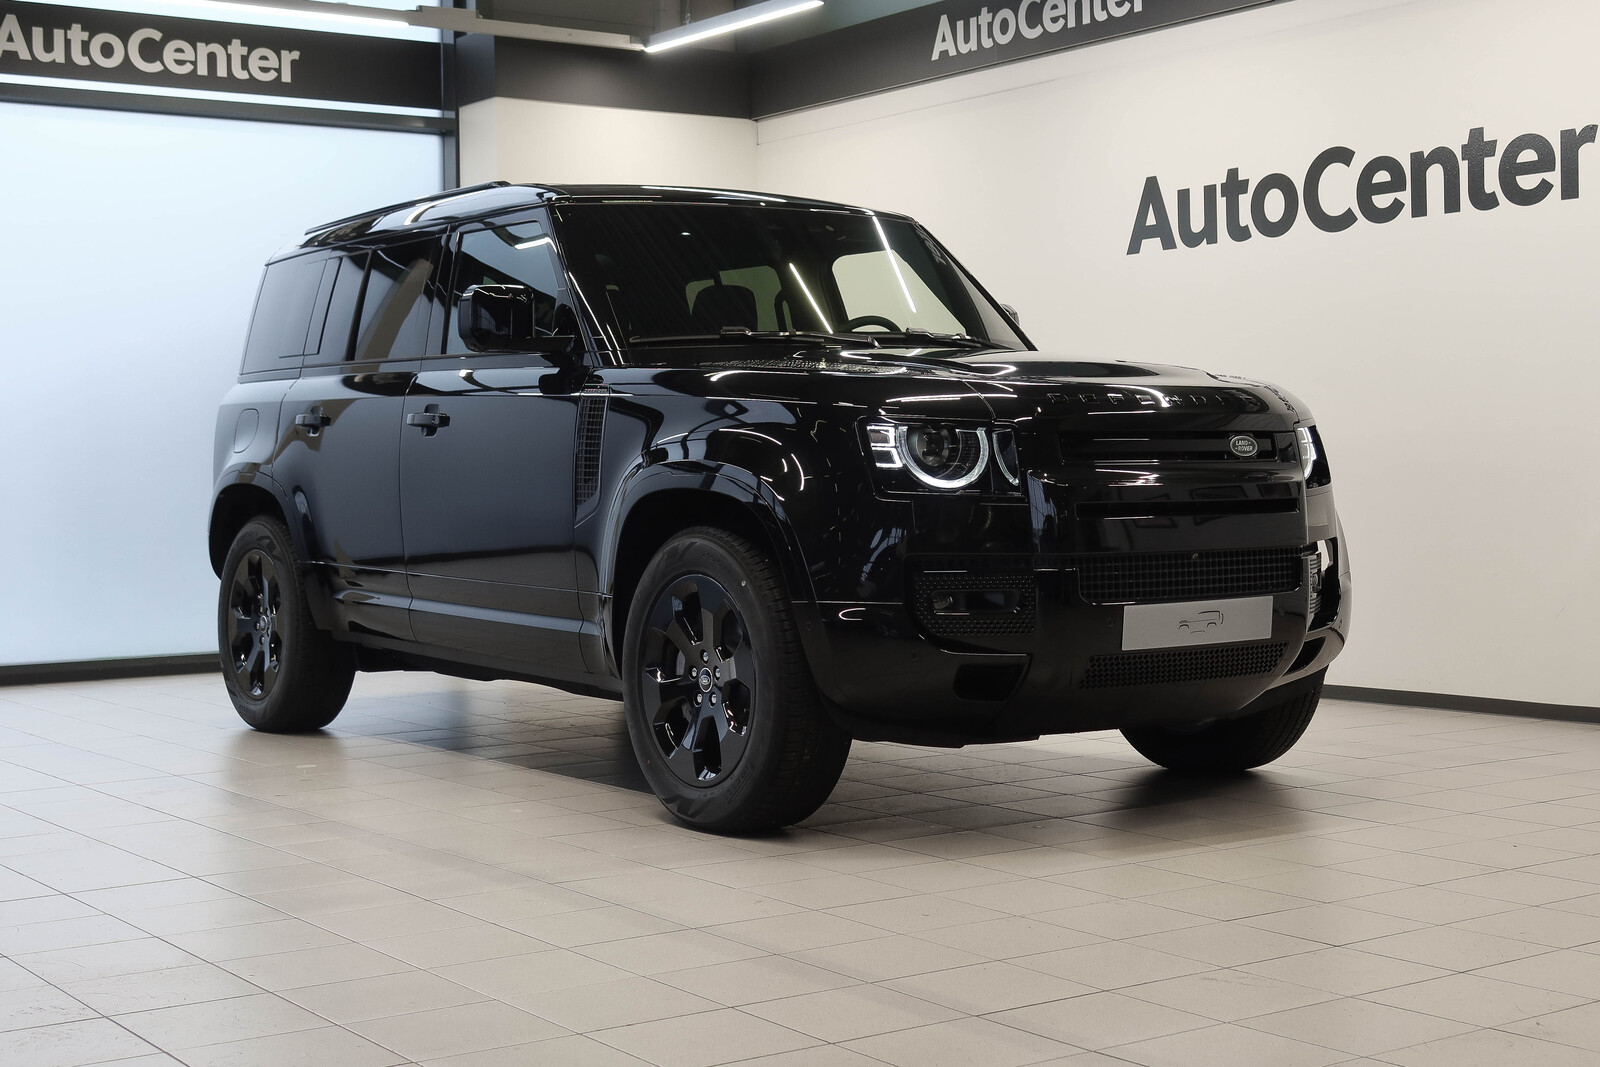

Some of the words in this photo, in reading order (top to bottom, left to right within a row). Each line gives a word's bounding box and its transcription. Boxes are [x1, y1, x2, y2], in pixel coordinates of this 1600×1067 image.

[0, 14, 300, 83] AutoCenter
[931, 0, 1143, 61] AutoCen
[1127, 124, 1598, 256] AutoCenter
